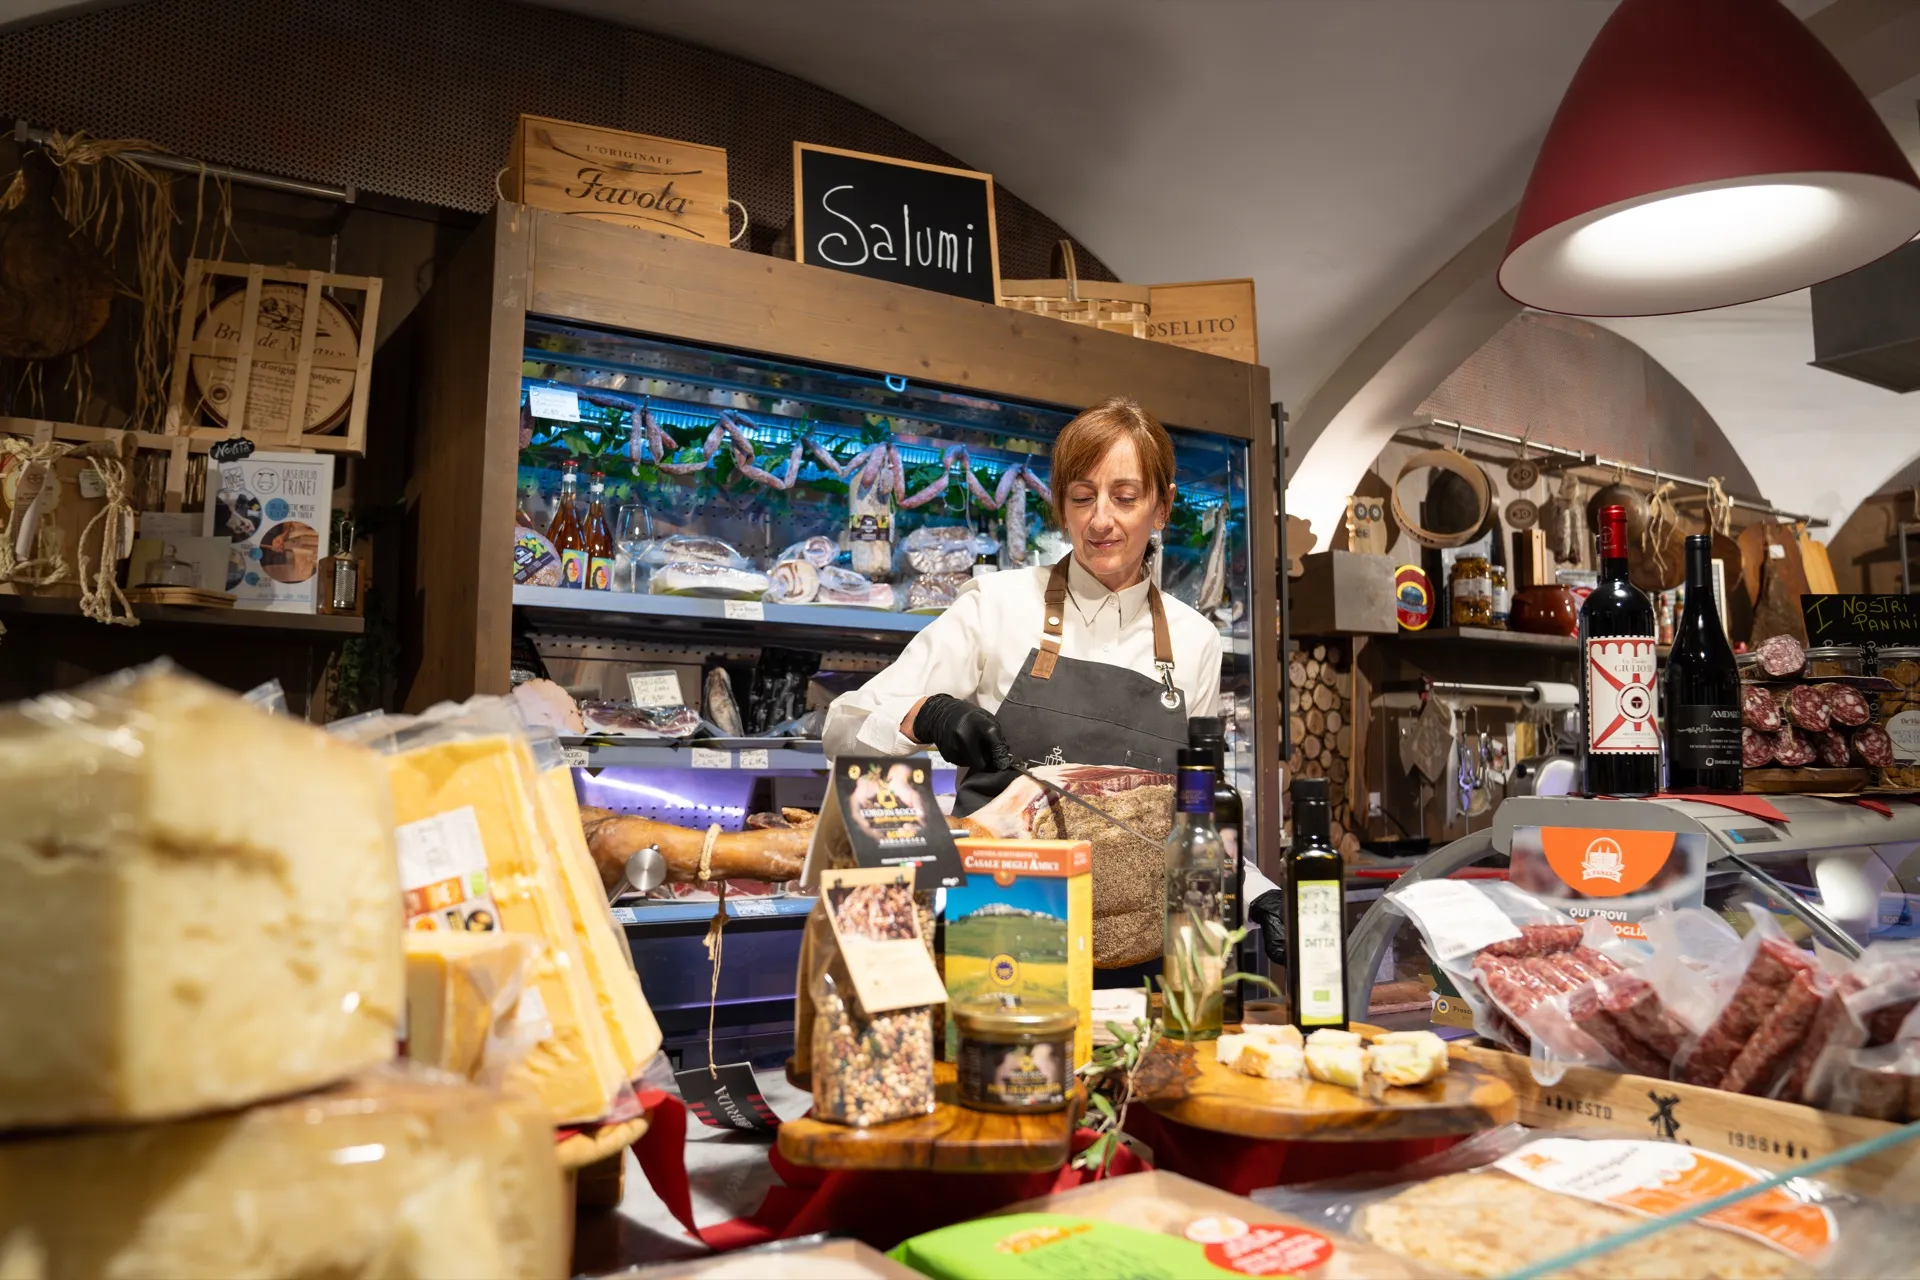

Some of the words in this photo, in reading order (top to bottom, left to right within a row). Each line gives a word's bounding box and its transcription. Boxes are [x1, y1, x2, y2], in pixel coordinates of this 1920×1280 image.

[586, 143, 674, 166] L'ORIGINALE
[564, 166, 688, 215] Favola
[817, 185, 975, 273] Salumi
[1149, 317, 1235, 338] OSELITO
[257, 332, 278, 349] de
[260, 362, 297, 376] d'origin
[1569, 907, 1590, 918] QUI
[1592, 909, 1628, 922] TROVI
[1613, 924, 1648, 937] OGLIA
